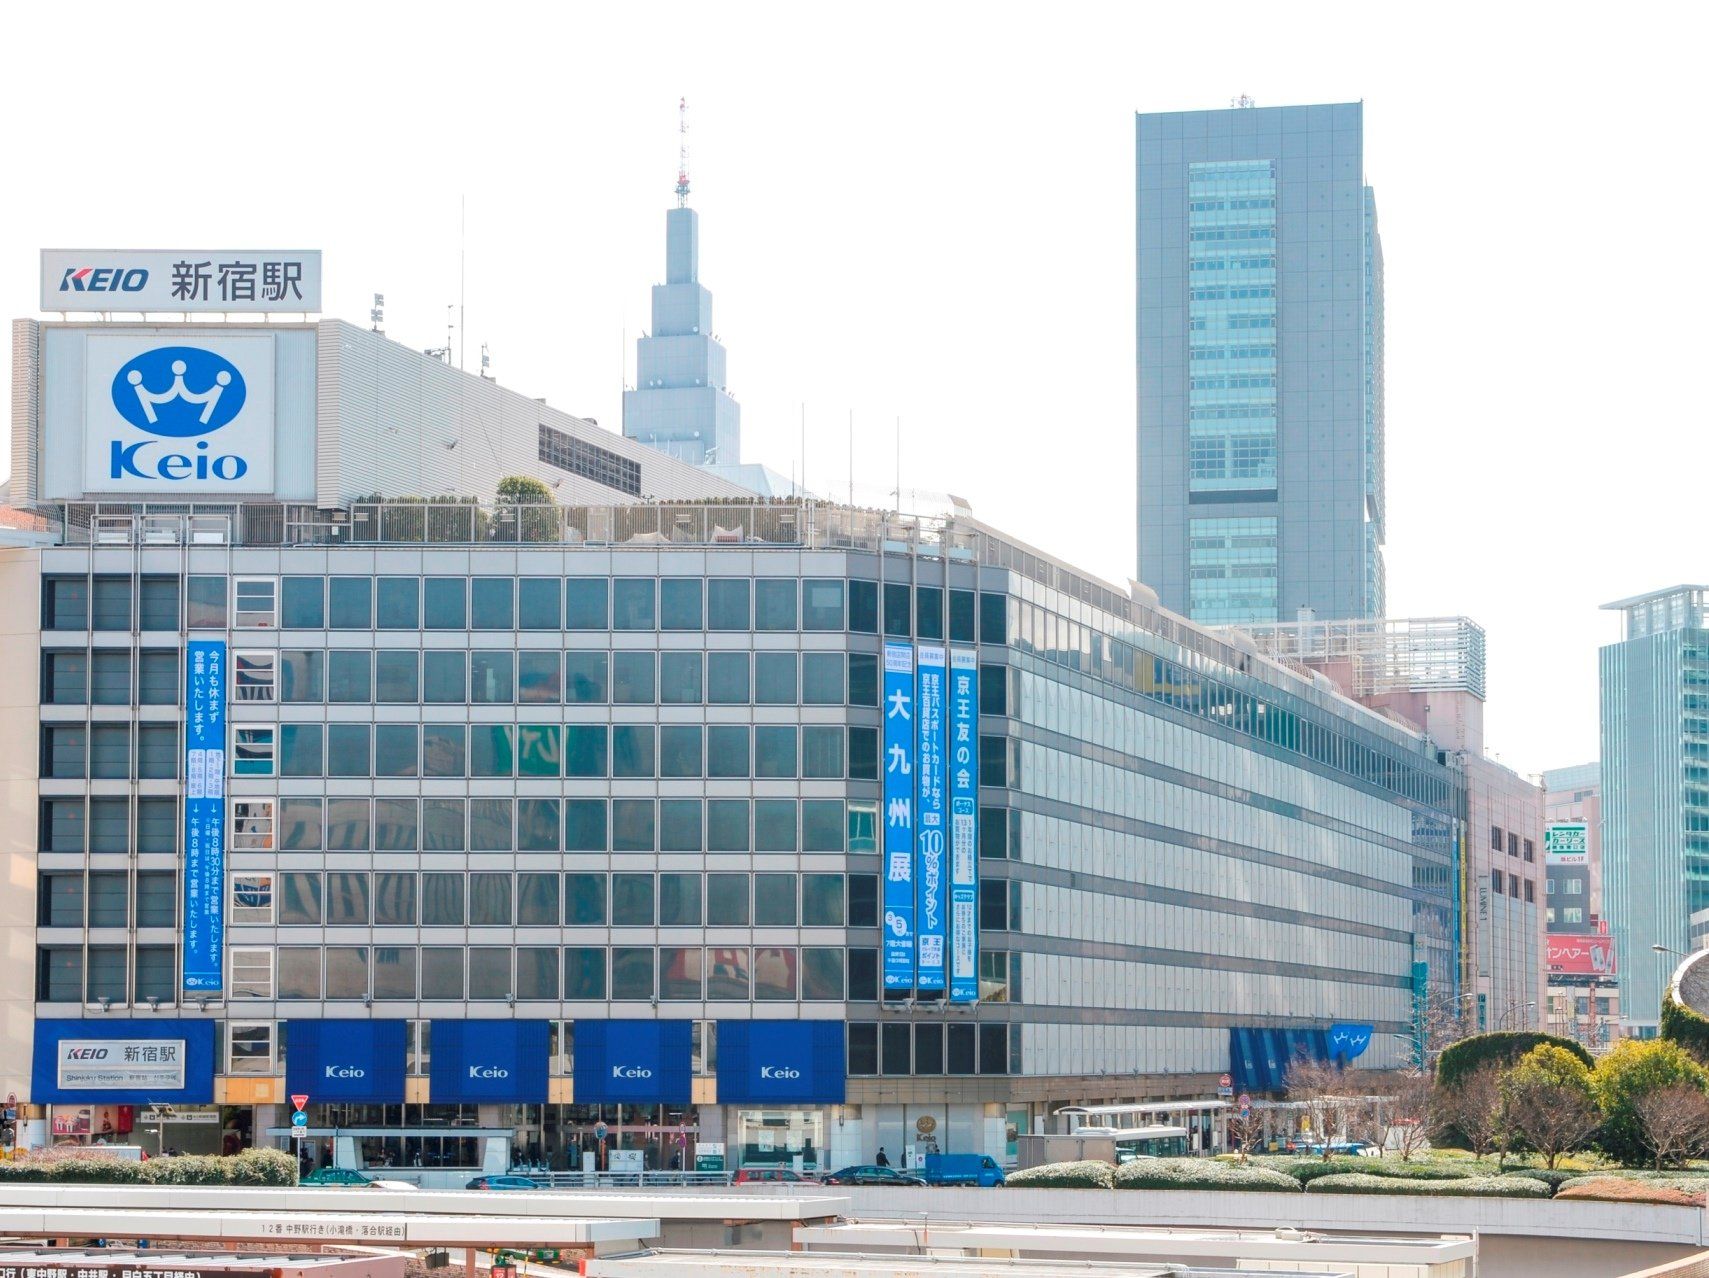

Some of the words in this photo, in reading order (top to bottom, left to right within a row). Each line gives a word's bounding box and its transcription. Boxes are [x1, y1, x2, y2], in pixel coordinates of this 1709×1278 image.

[59, 268, 149, 292] KEIO
[171, 260, 303, 301] 新宿駅
[110, 440, 248, 480] Keio
[193, 650, 205, 742] 営業いたします。
[208, 650, 220, 724] 今月も休まず
[931, 674, 941, 810] 京王パスポートカードなら
[956, 676, 970, 789] 京王友の会
[888, 689, 911, 882] 大九州展
[189, 817, 200, 954] 午後8時まで営業いたします。
[67, 1048, 108, 1060] KEIO
[124, 1046, 176, 1062] 新宿駅
[325, 1065, 365, 1078] Keio
[469, 1065, 508, 1079] Keio
[612, 1065, 652, 1079] Keio
[761, 1066, 800, 1079] Keio
